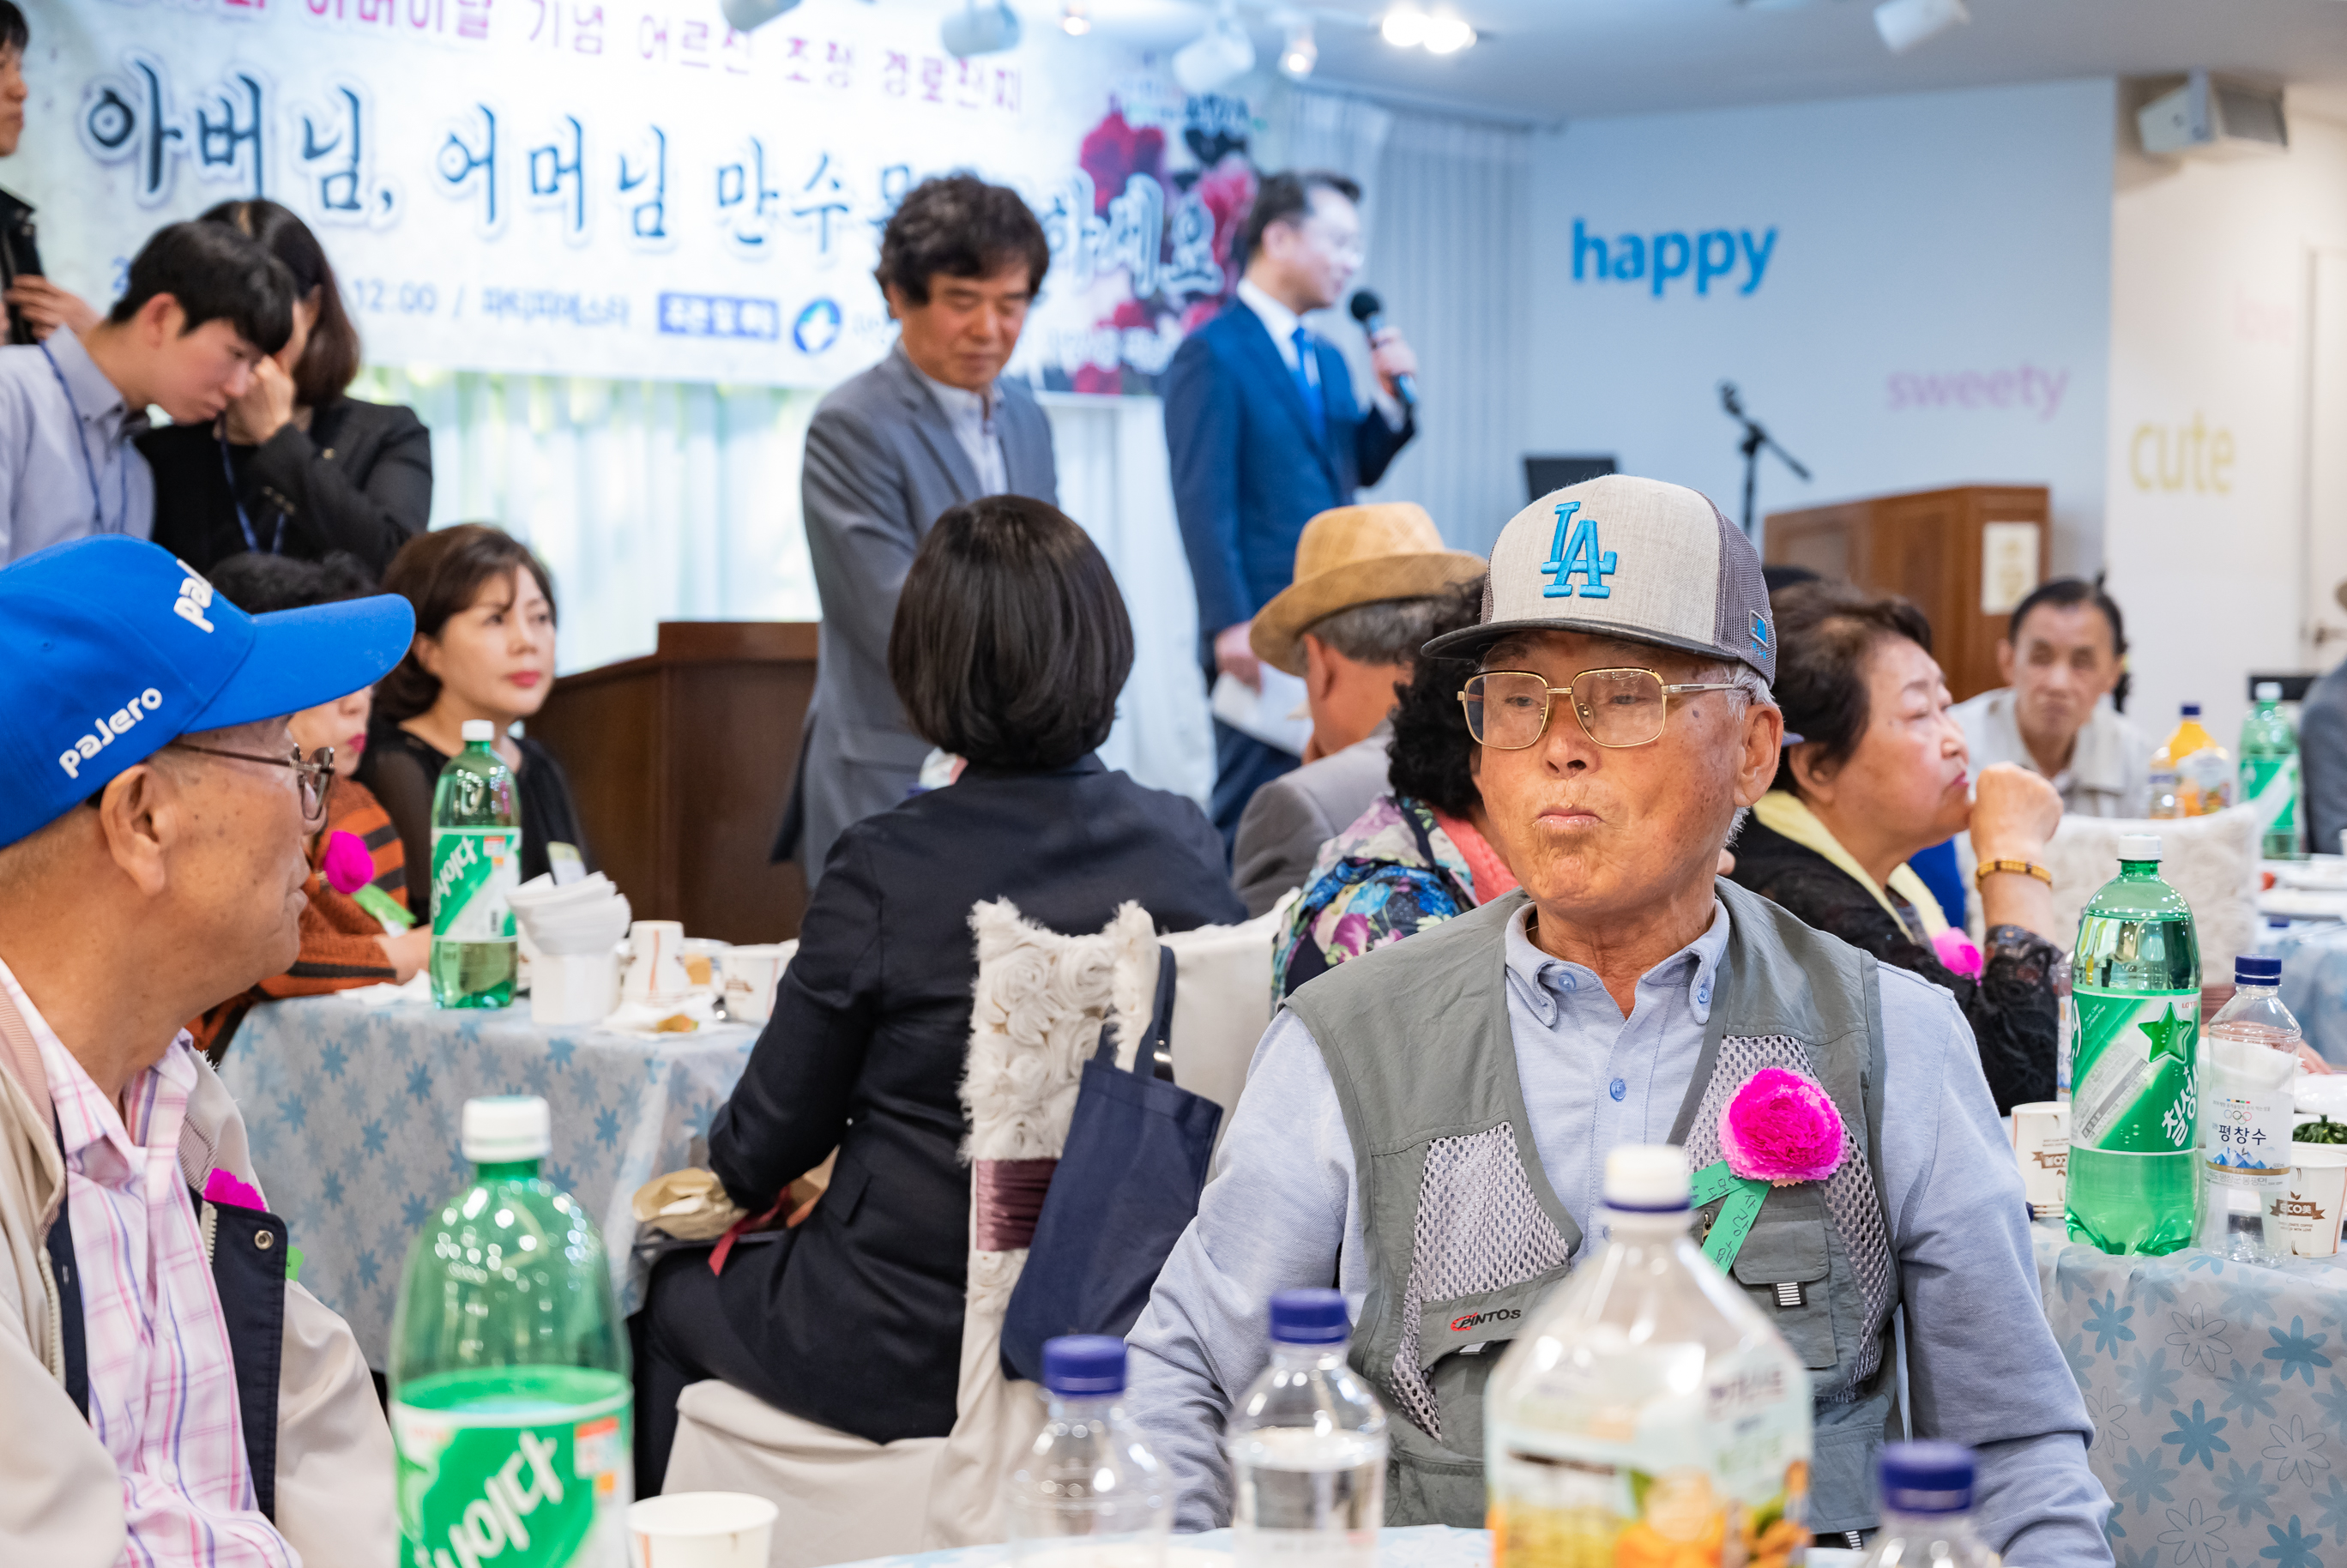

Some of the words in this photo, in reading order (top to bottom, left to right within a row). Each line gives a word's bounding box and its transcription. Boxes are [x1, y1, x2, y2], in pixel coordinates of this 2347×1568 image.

[529, 0, 604, 55] 기념
[638, 13, 753, 75] 어르신
[784, 36, 854, 88] 초청
[87, 58, 395, 213] 아버님,
[438, 102, 668, 238] 어머님
[1572, 217, 1778, 297] happy
[1886, 363, 2069, 419] sweety
[2129, 412, 2235, 494] cute
[1541, 502, 1617, 599] LA
[2218, 1125, 2266, 1146] 평창수
